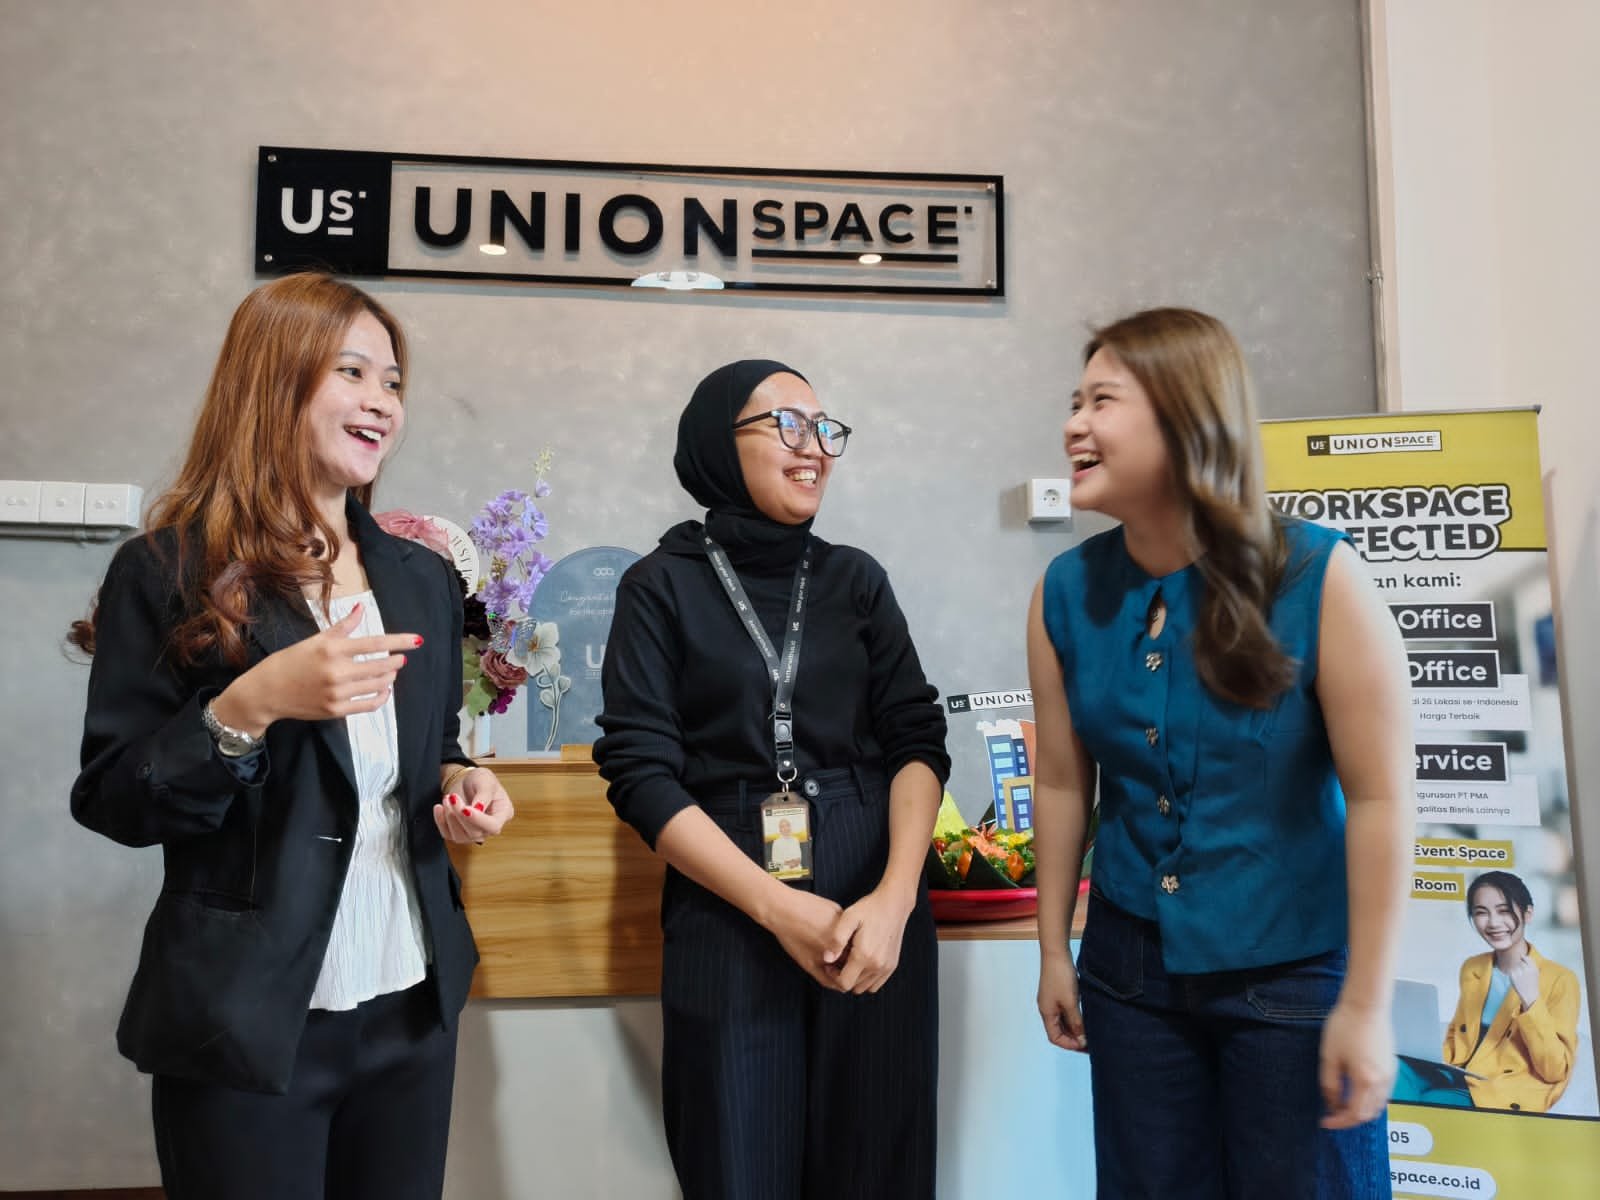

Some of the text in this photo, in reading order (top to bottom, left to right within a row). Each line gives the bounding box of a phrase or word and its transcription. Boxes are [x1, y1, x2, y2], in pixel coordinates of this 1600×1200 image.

[1404, 572, 1462, 588] kami:
[1397, 607, 1483, 631] Office
[1408, 659, 1488, 682] Office
[1434, 696, 1461, 706] Lokasi
[1419, 712, 1481, 721] Harga Terbaik
[1470, 791, 1489, 800] PMA
[1449, 805, 1475, 815] Bisnis
[1476, 807, 1511, 817] Lainnya
[1415, 845, 1506, 861] Event Space
[1414, 878, 1457, 892] Room
[1388, 1130, 1410, 1144] 05
